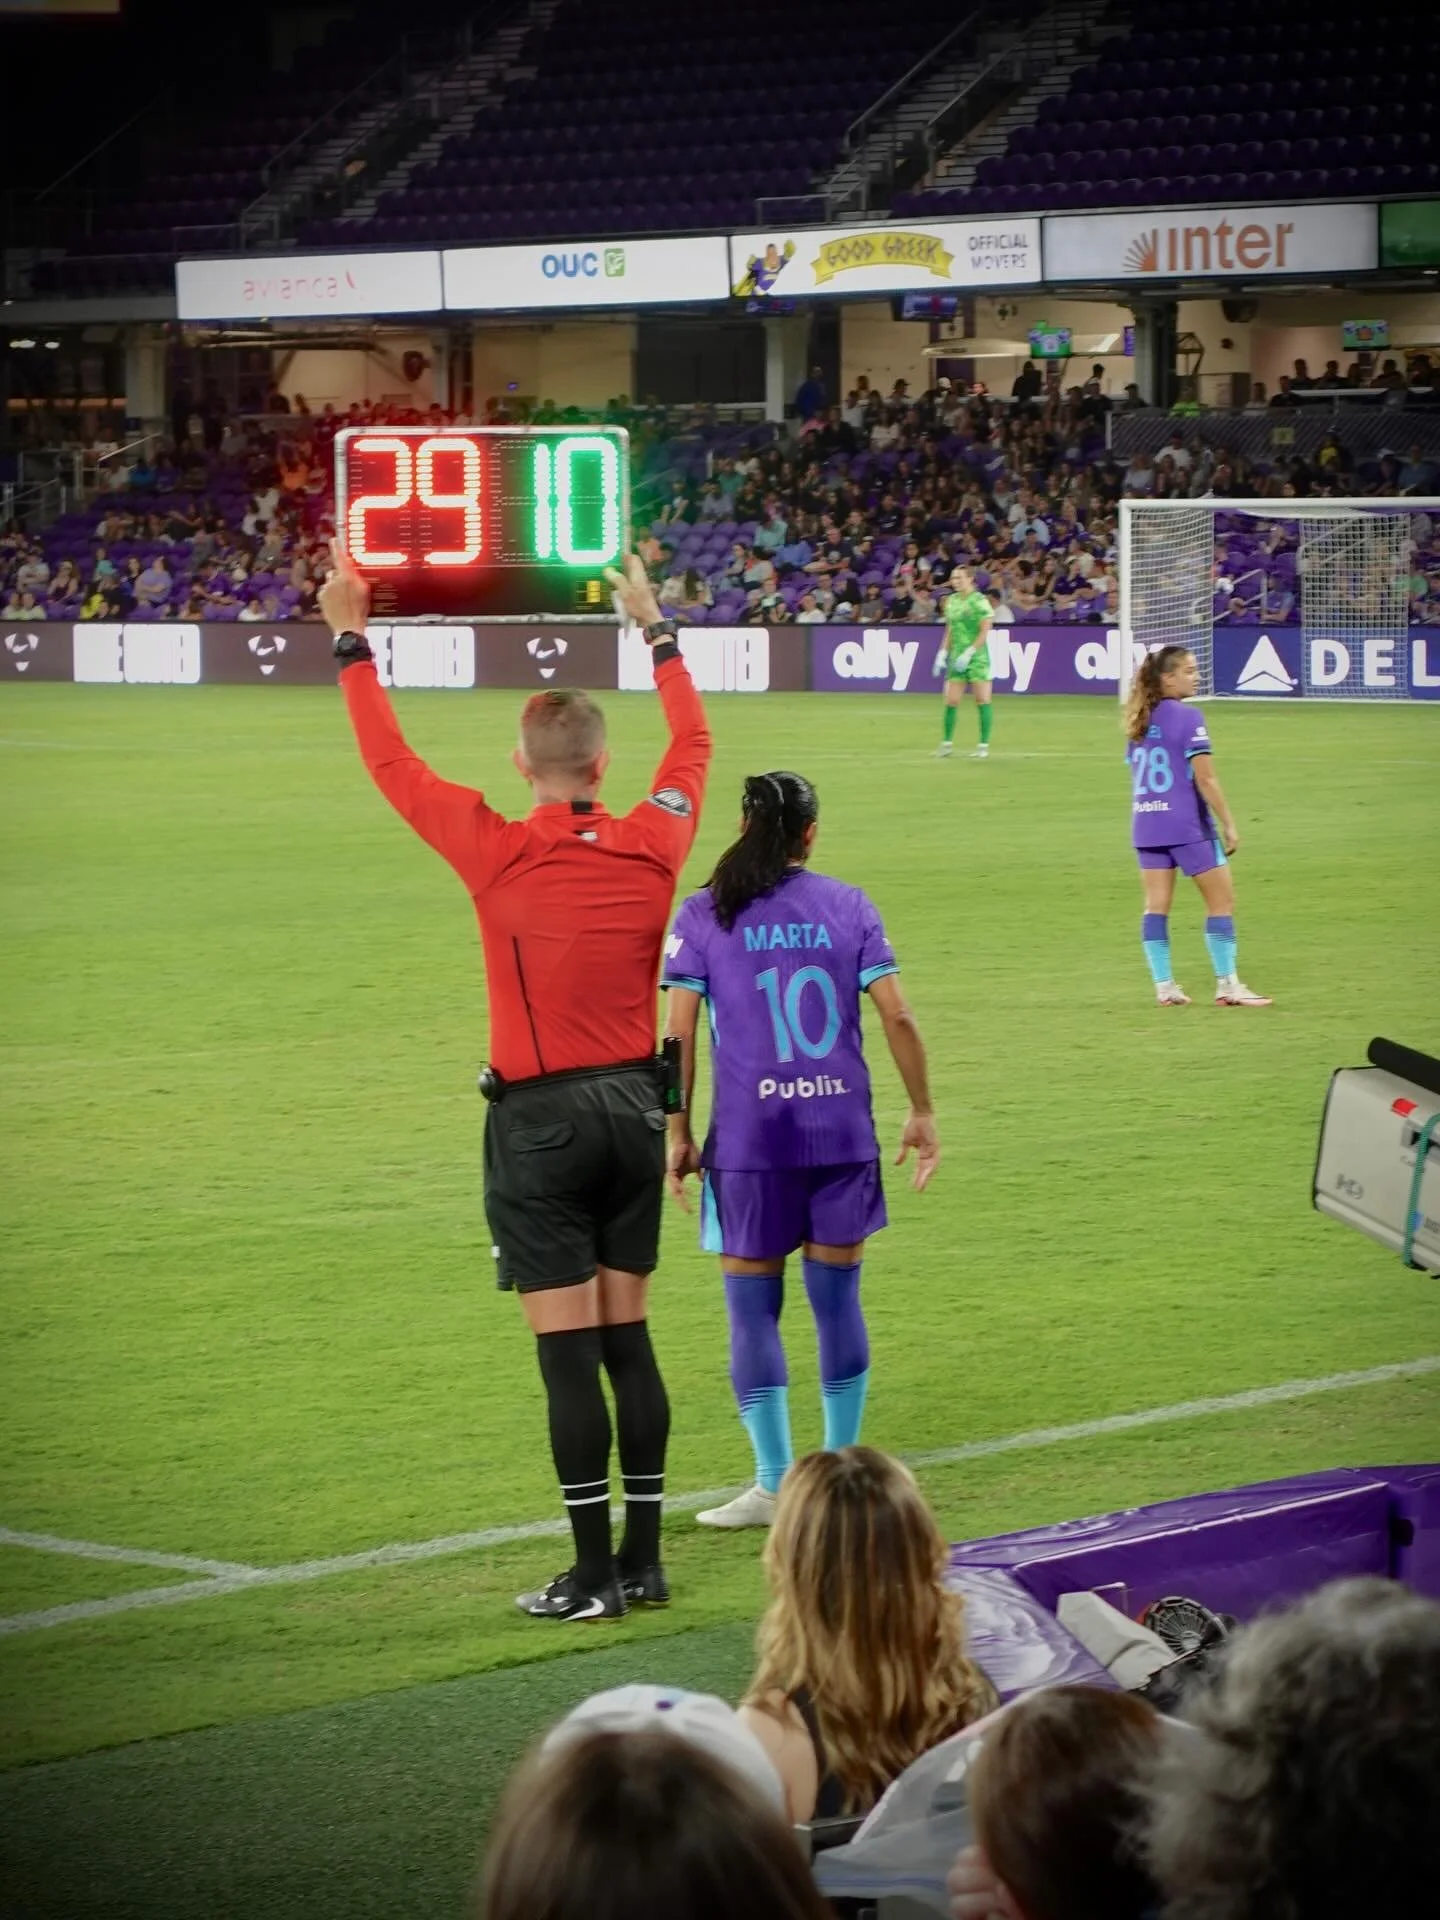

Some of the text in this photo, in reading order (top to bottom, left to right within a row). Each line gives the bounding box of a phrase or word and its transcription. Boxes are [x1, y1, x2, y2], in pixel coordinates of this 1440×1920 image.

[827, 235, 940, 267] GOOD GREEK
[967, 233, 1029, 251] OFFICIAL
[970, 253, 1028, 270] MOVERS
[1167, 217, 1295, 272] inter
[541, 251, 598, 279] OUC
[242, 276, 338, 301] avianca
[347, 436, 620, 566] 29 10
[832, 629, 920, 692] ally
[986, 629, 1041, 692] lly
[1131, 745, 1175, 796] 28
[743, 922, 833, 952] MARTA
[755, 964, 843, 1063] 10
